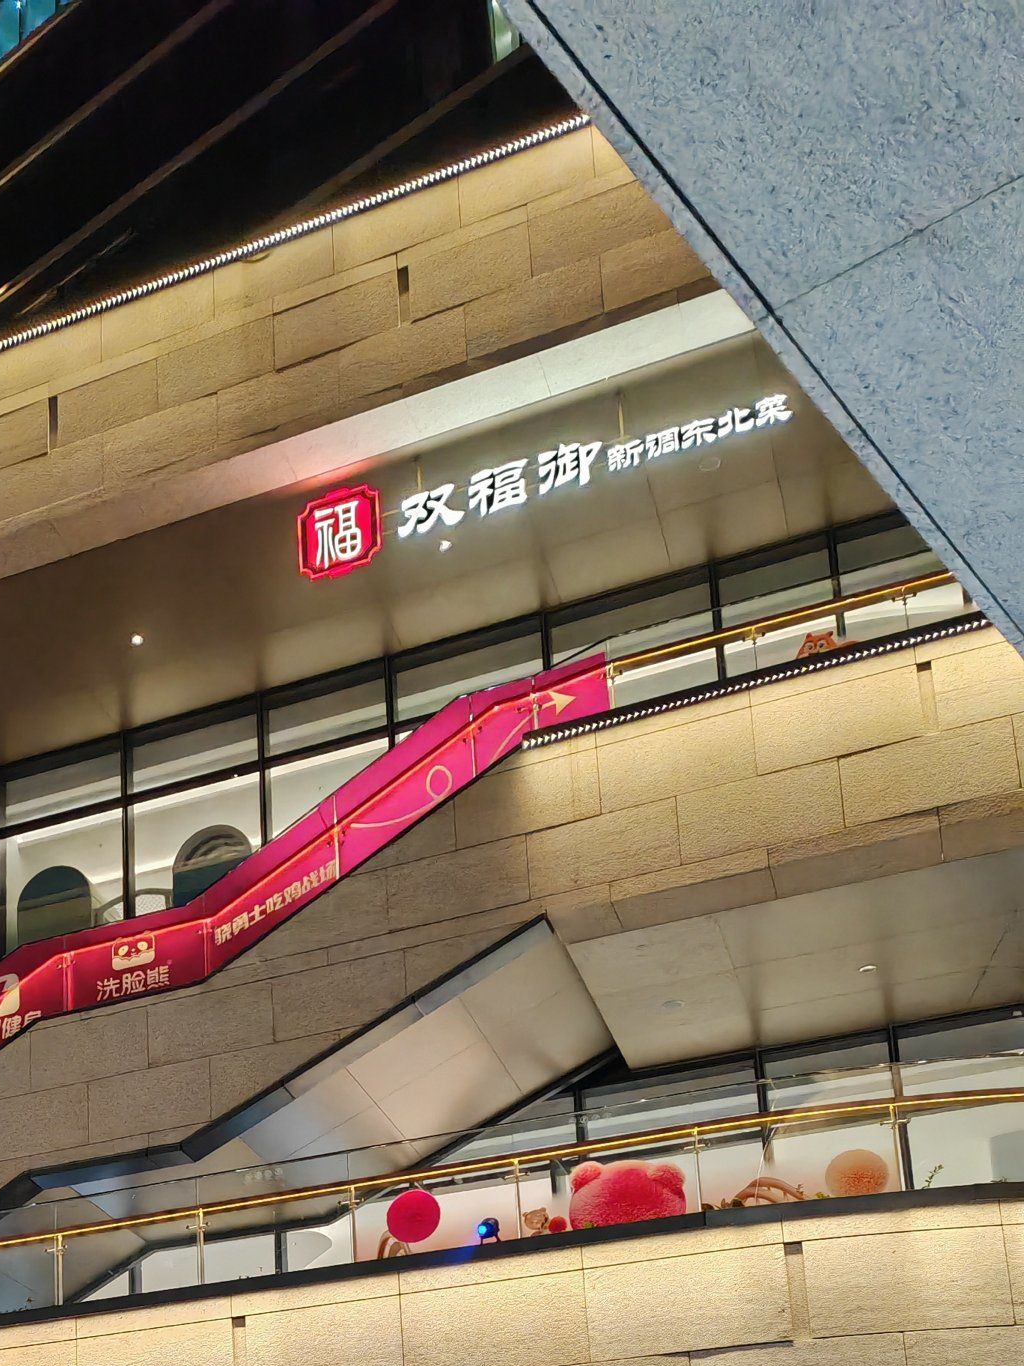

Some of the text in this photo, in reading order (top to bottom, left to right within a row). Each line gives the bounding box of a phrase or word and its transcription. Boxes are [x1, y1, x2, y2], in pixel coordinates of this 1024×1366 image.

[314, 394, 794, 567] 福 双福御 新调东北菜
[96, 966, 170, 1001] 洗脸熊
